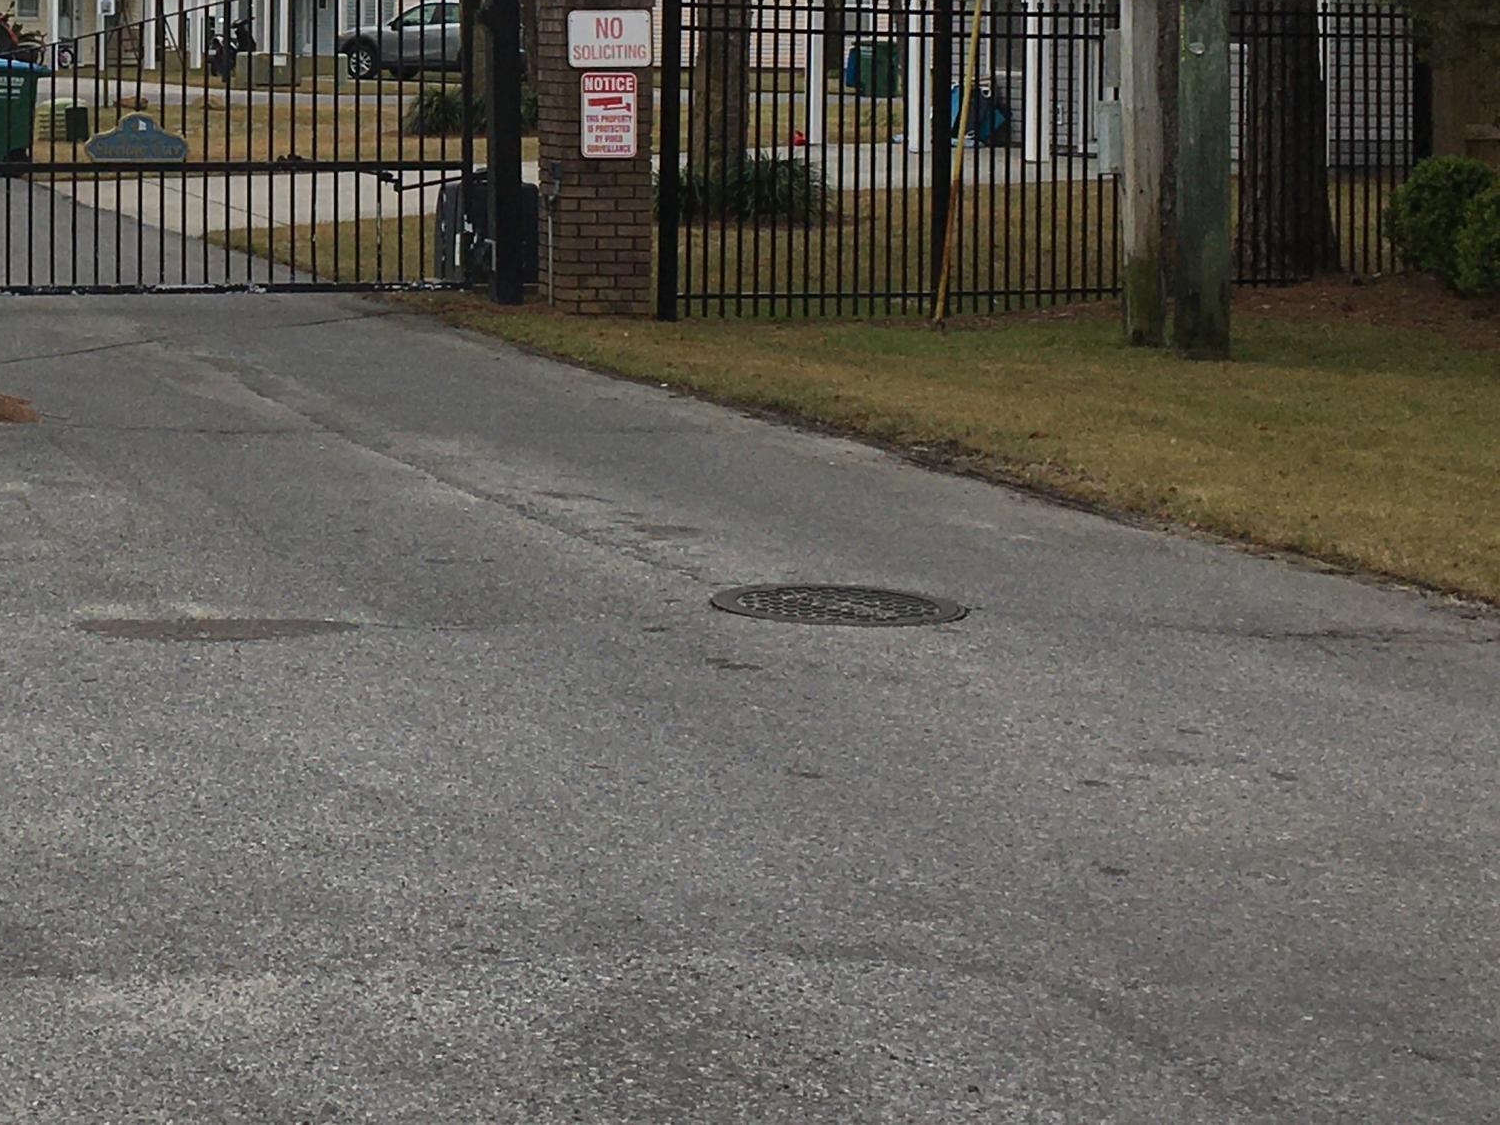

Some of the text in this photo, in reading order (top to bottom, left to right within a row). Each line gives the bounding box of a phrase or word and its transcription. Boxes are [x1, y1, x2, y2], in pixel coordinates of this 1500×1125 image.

[595, 17, 623, 39] NO
[573, 44, 646, 60] SOLICITING
[584, 77, 633, 91] NOTICE
[587, 144, 631, 152] SURVEILLANCE
